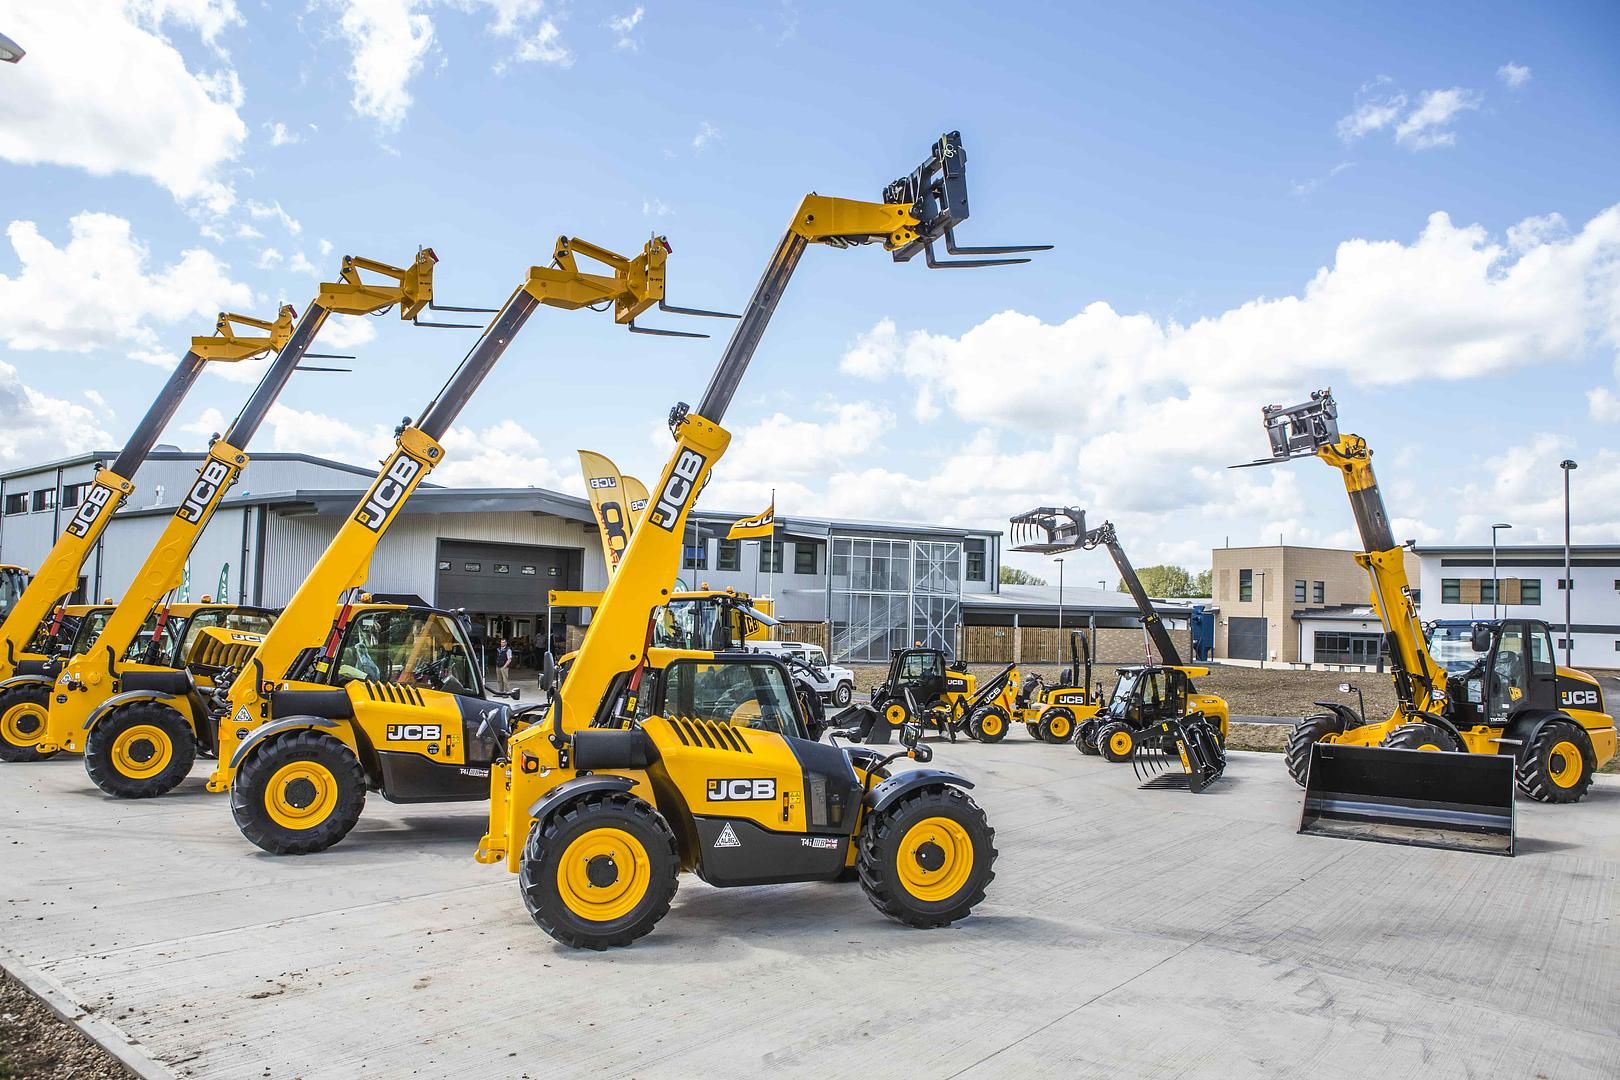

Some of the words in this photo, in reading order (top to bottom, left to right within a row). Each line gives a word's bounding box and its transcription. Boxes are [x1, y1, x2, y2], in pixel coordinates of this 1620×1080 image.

[184, 461, 228, 522] JCB
[365, 455, 419, 529] JCB
[657, 450, 703, 529] JCB
[73, 486, 111, 537] JCB
[984, 688, 1000, 704] JCB
[1059, 695, 1084, 704] JCB
[1561, 690, 1598, 705] JCB
[387, 725, 441, 740] JCB
[708, 779, 775, 800] JCB
